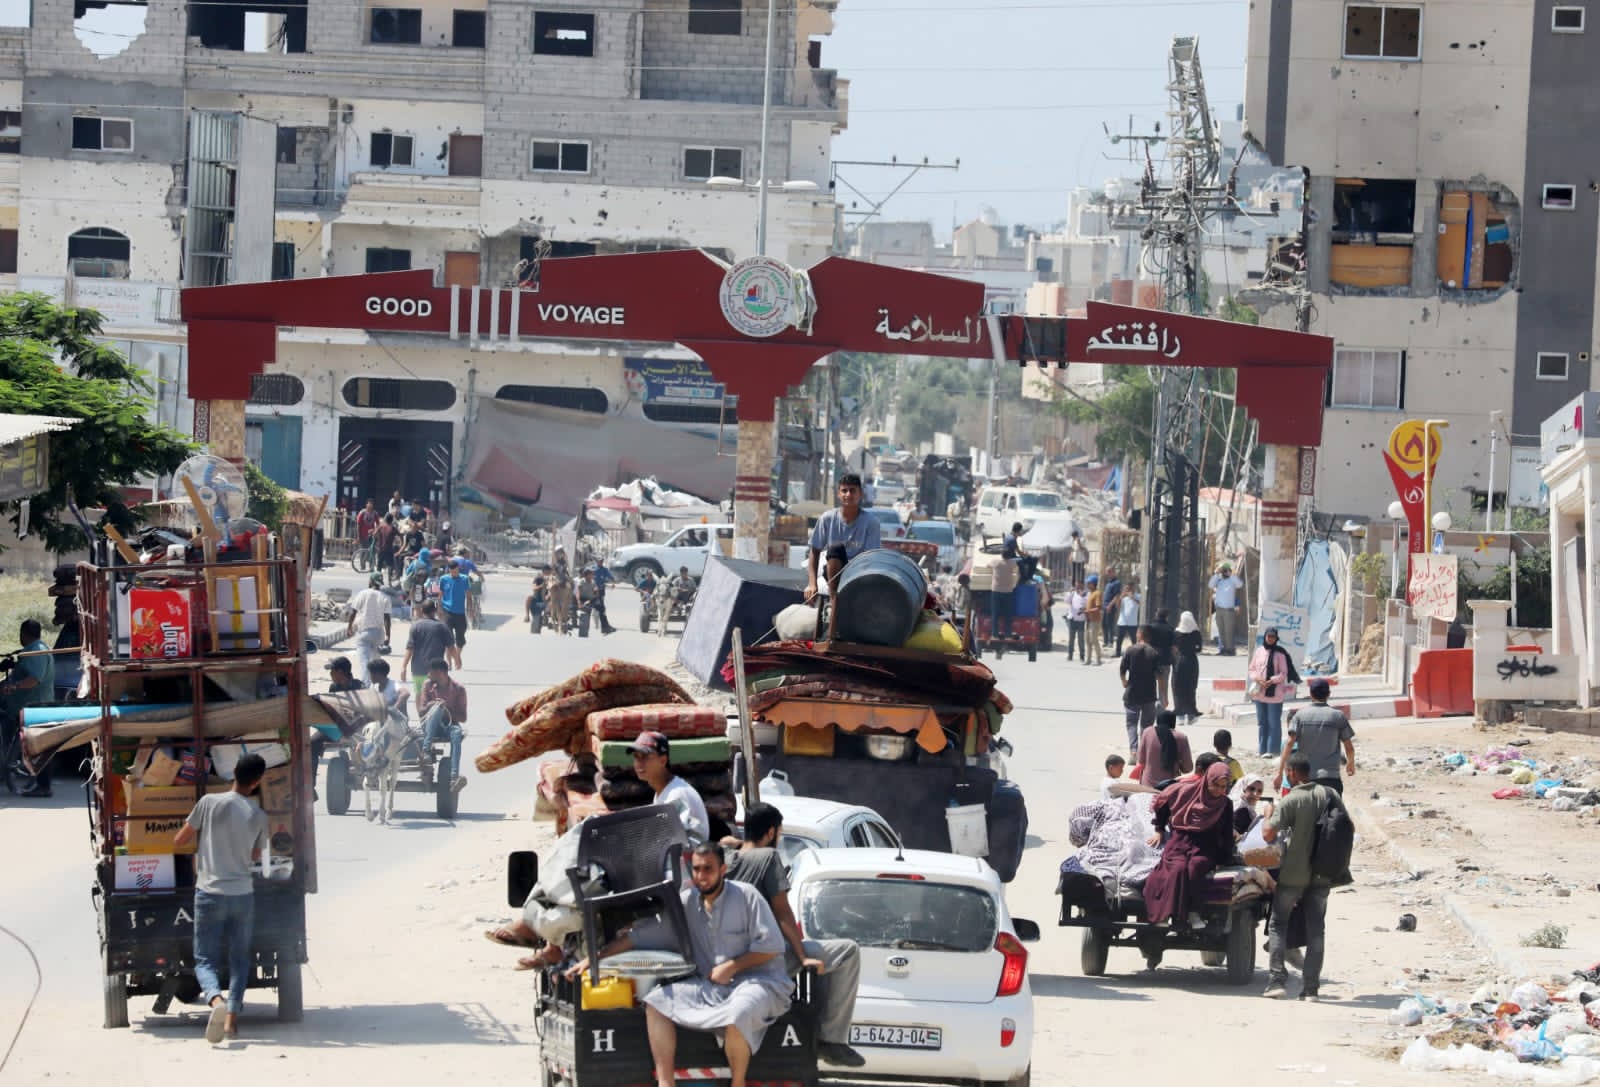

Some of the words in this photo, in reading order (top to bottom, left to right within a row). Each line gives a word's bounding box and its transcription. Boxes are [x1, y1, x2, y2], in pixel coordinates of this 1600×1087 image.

[365, 296, 432, 317] GOOD
[537, 303, 625, 325] VOYAGE
[875, 308, 982, 344] السلامة
[1086, 322, 1181, 358] رافقتكم
[160, 621, 184, 657] JOKER
[592, 1029, 616, 1053] H
[781, 1023, 802, 1047] A
[853, 1026, 926, 1045] 3-6423-04
